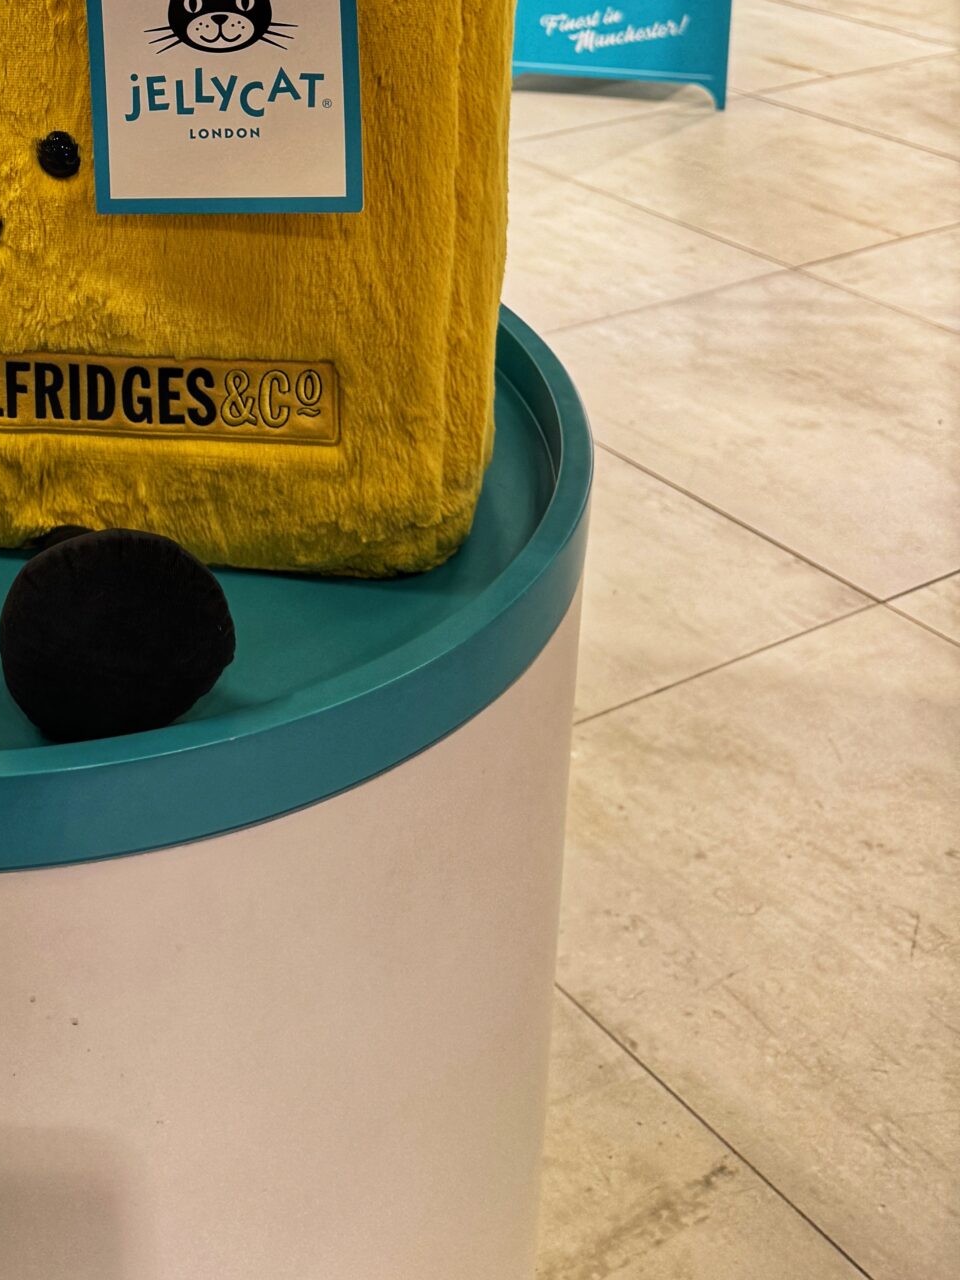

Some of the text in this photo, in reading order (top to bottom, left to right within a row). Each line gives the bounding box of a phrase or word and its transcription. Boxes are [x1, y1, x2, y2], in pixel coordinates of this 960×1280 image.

[540, 6, 623, 36] Finest in
[568, 14, 690, 53] Manchester!
[189, 127, 261, 140] LONDON
